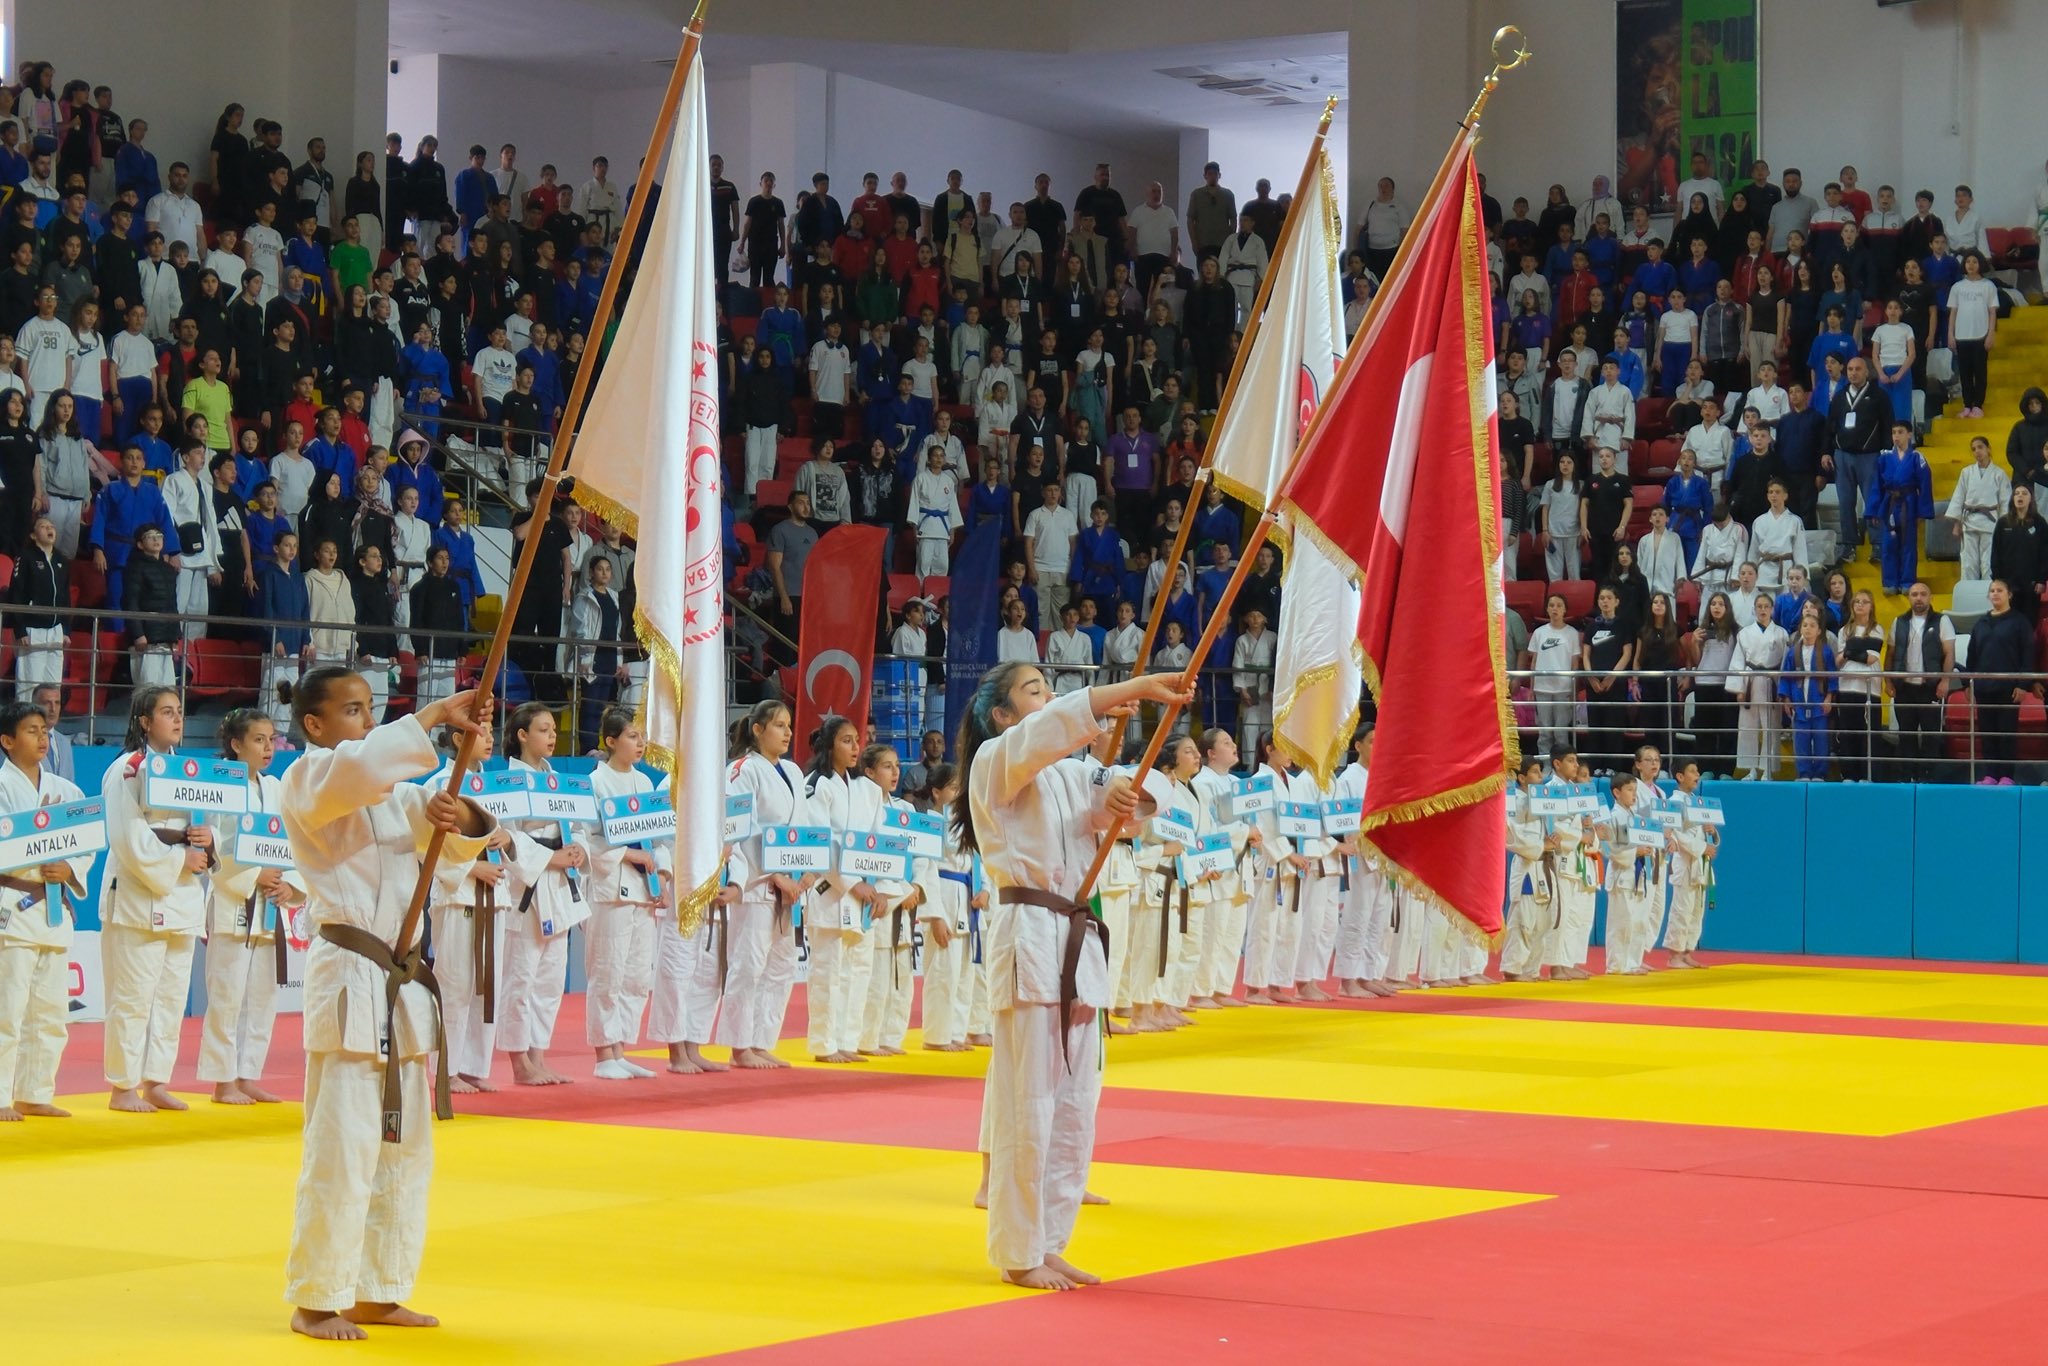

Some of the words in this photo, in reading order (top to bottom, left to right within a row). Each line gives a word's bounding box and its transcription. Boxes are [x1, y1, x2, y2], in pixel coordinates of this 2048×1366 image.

[43, 336, 57, 349] 98
[174, 787, 223, 804] ARDAHAN
[481, 801, 508, 814] AHYA
[548, 799, 576, 813] BARTIN
[25, 833, 78, 857] ANTALYA
[780, 850, 814, 866] İSTANBUL
[854, 856, 892, 873] GAZİANTEP
